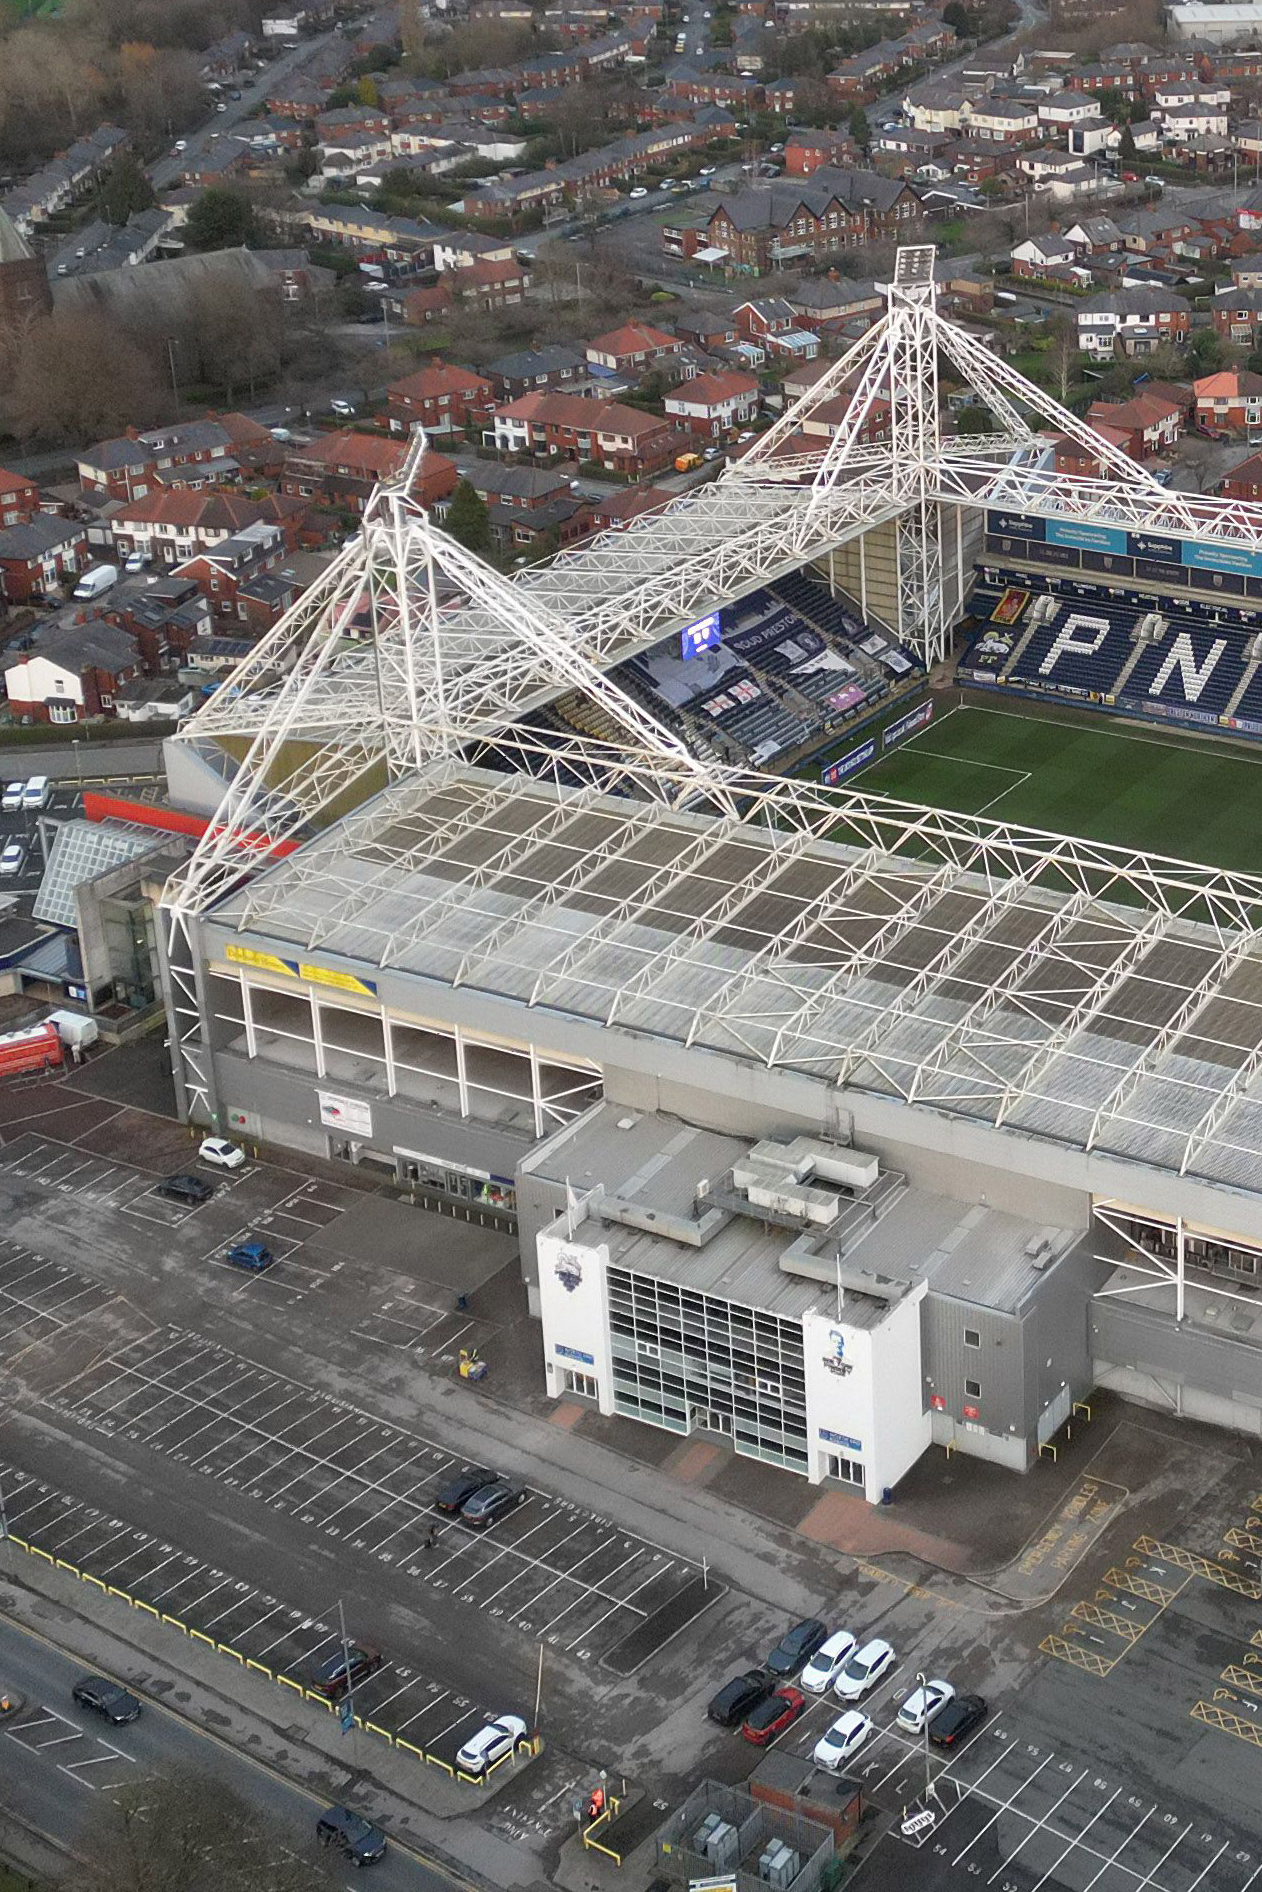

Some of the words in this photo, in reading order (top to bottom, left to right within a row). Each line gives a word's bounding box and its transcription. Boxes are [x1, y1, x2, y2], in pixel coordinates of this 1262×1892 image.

[1242, 1698, 1258, 1712] F
[1128, 1796, 1143, 1808] 59
[1163, 1813, 1178, 1826] 60
[1200, 1832, 1213, 1844] 61
[932, 1844, 948, 1856] 54
[1235, 1850, 1251, 1862] 62
